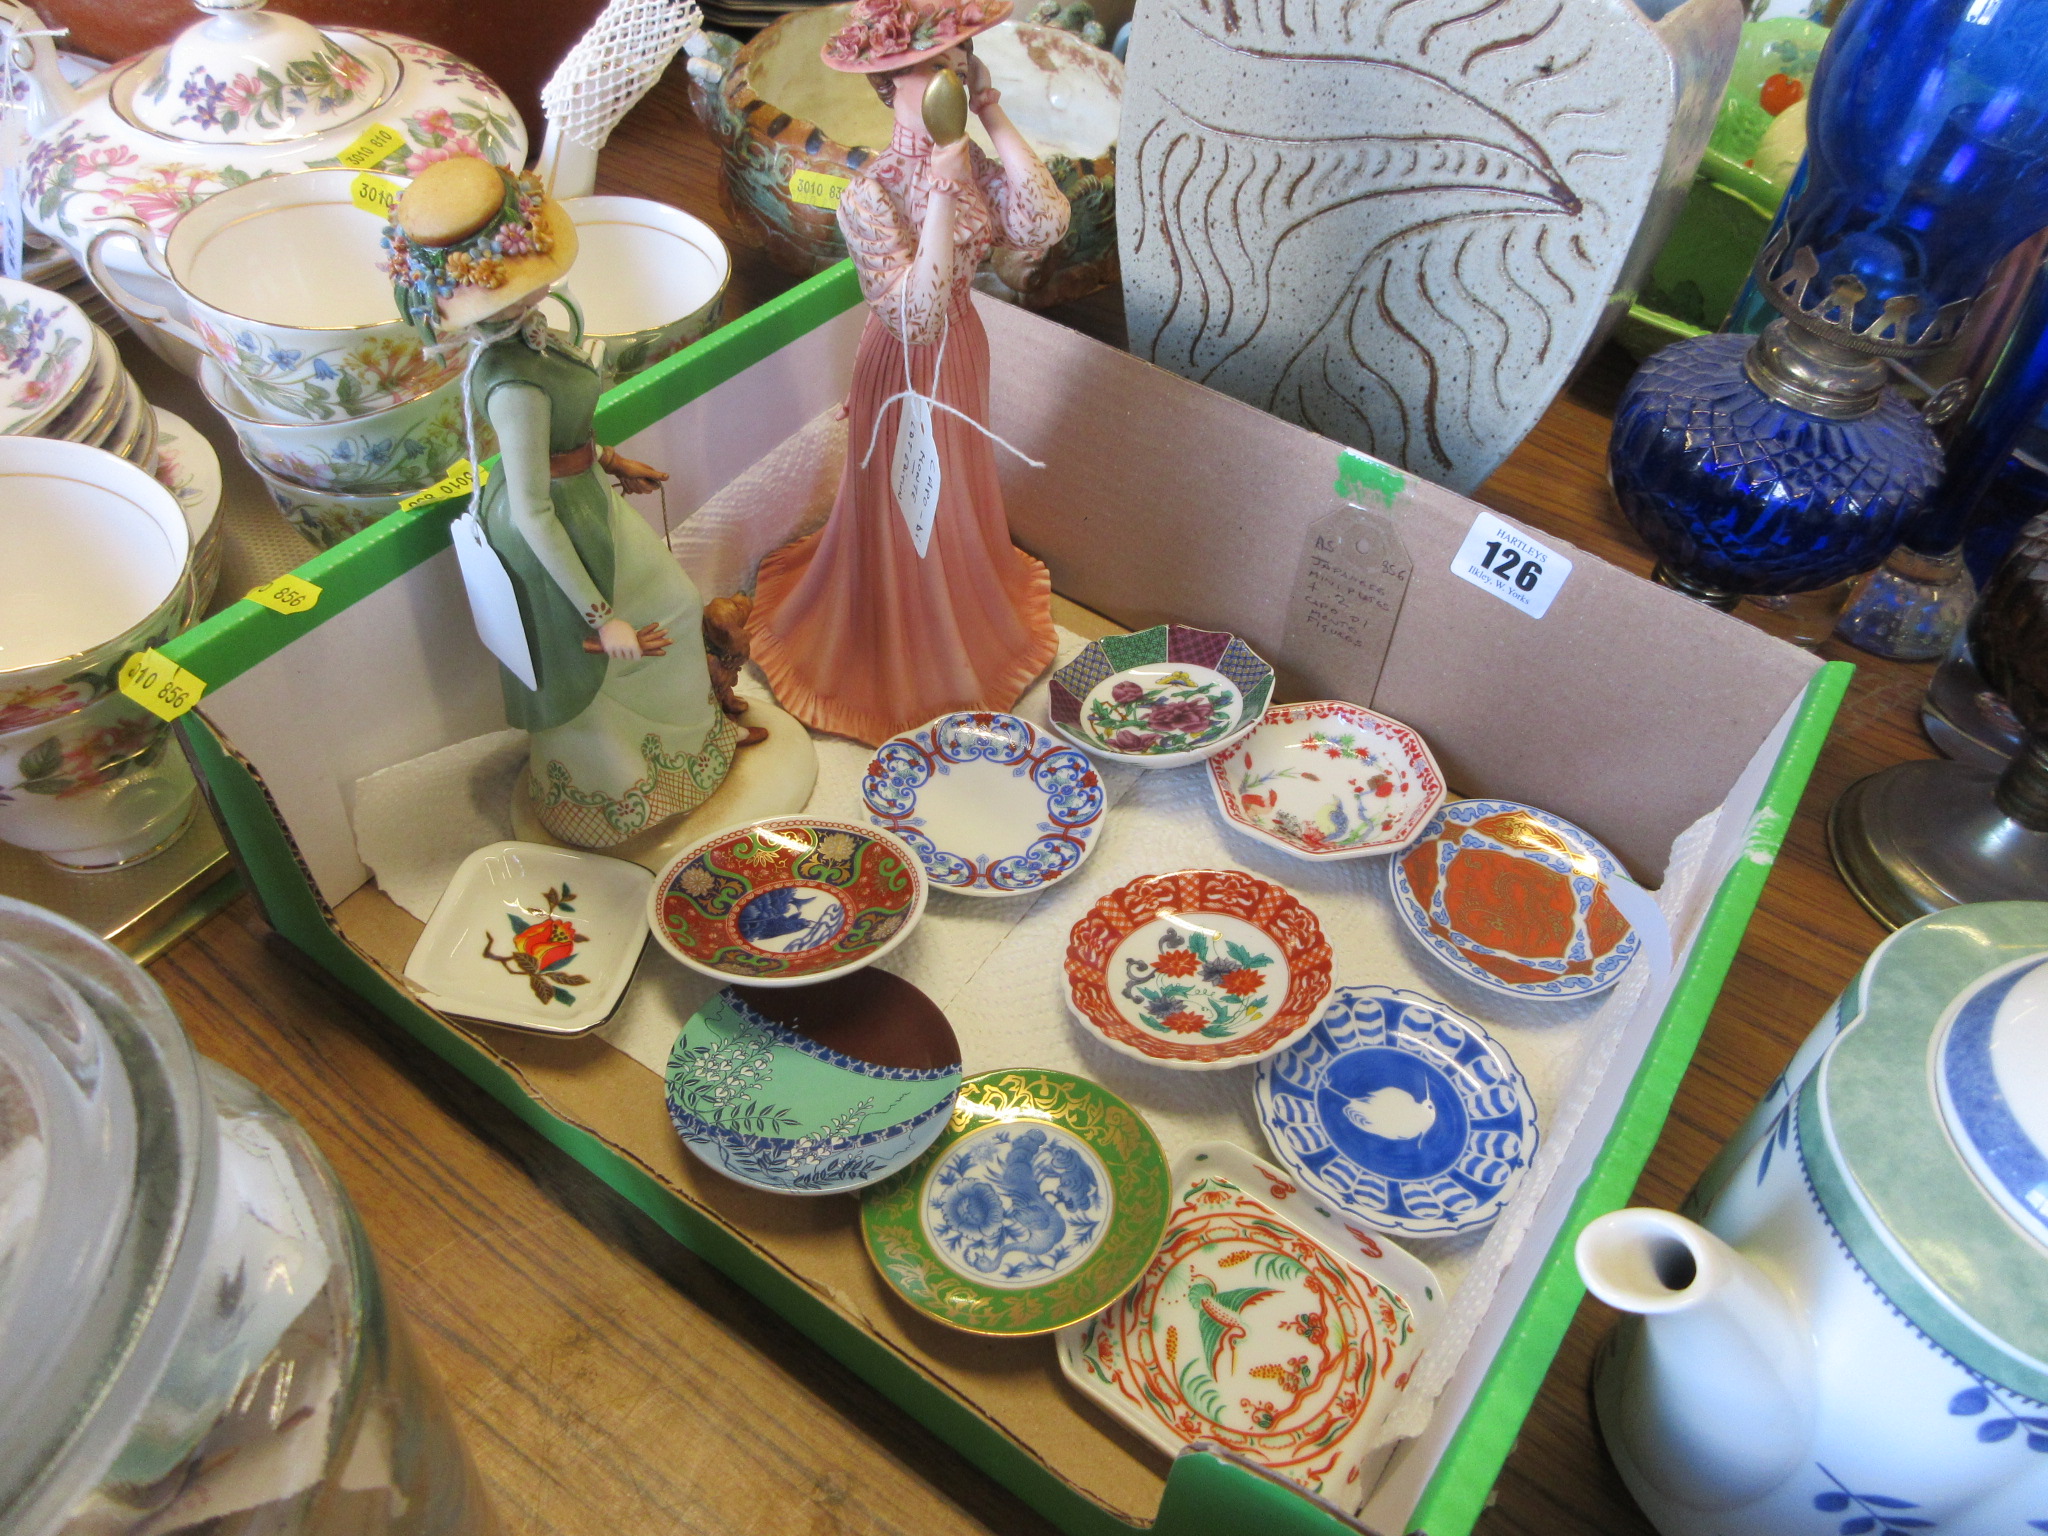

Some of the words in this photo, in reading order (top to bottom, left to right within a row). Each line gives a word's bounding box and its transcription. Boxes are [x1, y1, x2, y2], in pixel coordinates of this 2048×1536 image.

[346, 146, 374, 165] 3010
[370, 130, 392, 147] 810
[360, 182, 394, 208] 3010
[797, 178, 823, 196] 3010
[1496, 528, 1548, 563] HARTLEYS
[1311, 555, 1385, 596] JAPANESE
[1382, 560, 1406, 581] 856
[1481, 541, 1543, 592] 126
[273, 587, 307, 607] 856
[1468, 565, 1493, 585] Ilkley,
[1495, 579, 1505, 592] W.
[1508, 587, 1530, 605] Yorks
[158, 682, 190, 708] 856
